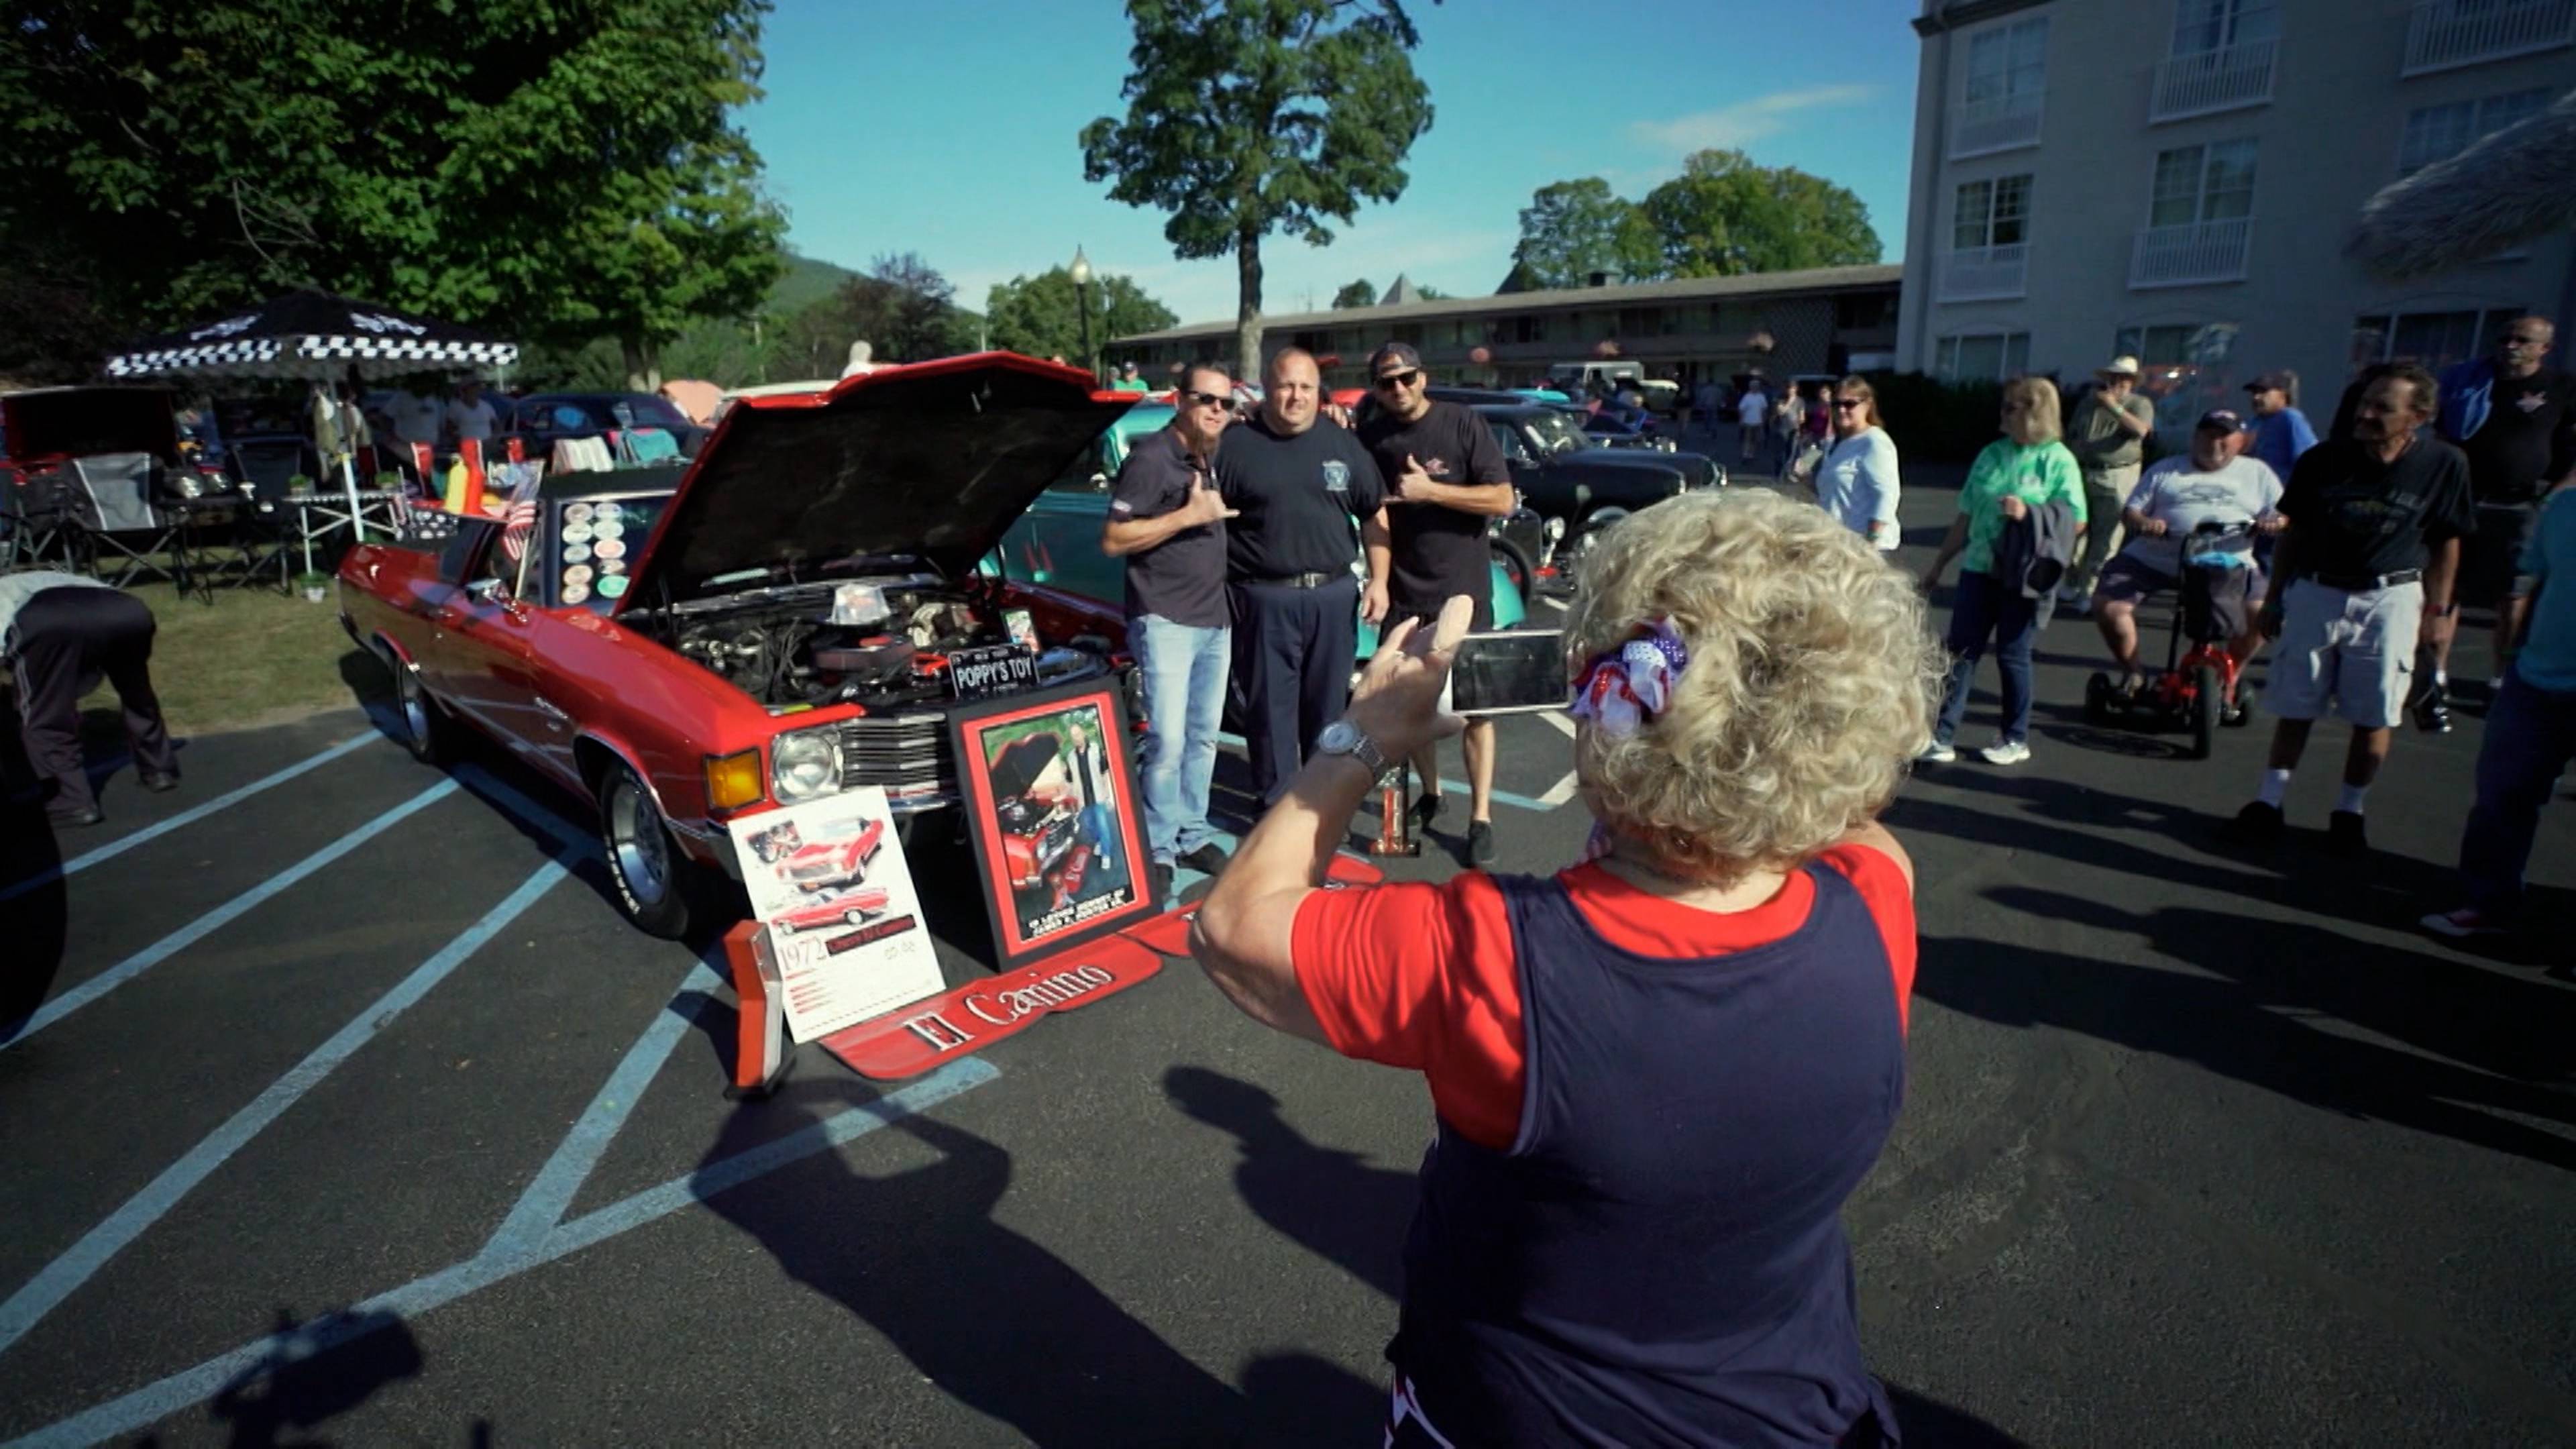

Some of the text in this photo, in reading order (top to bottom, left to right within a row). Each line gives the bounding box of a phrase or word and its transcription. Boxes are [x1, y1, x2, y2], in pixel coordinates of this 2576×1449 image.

[956, 659, 1009, 689] POPPY'S
[1008, 657, 1032, 679] TOY
[780, 935, 828, 971] 1972
[902, 1010, 975, 1052] El
[963, 964, 1117, 1026] Camino
